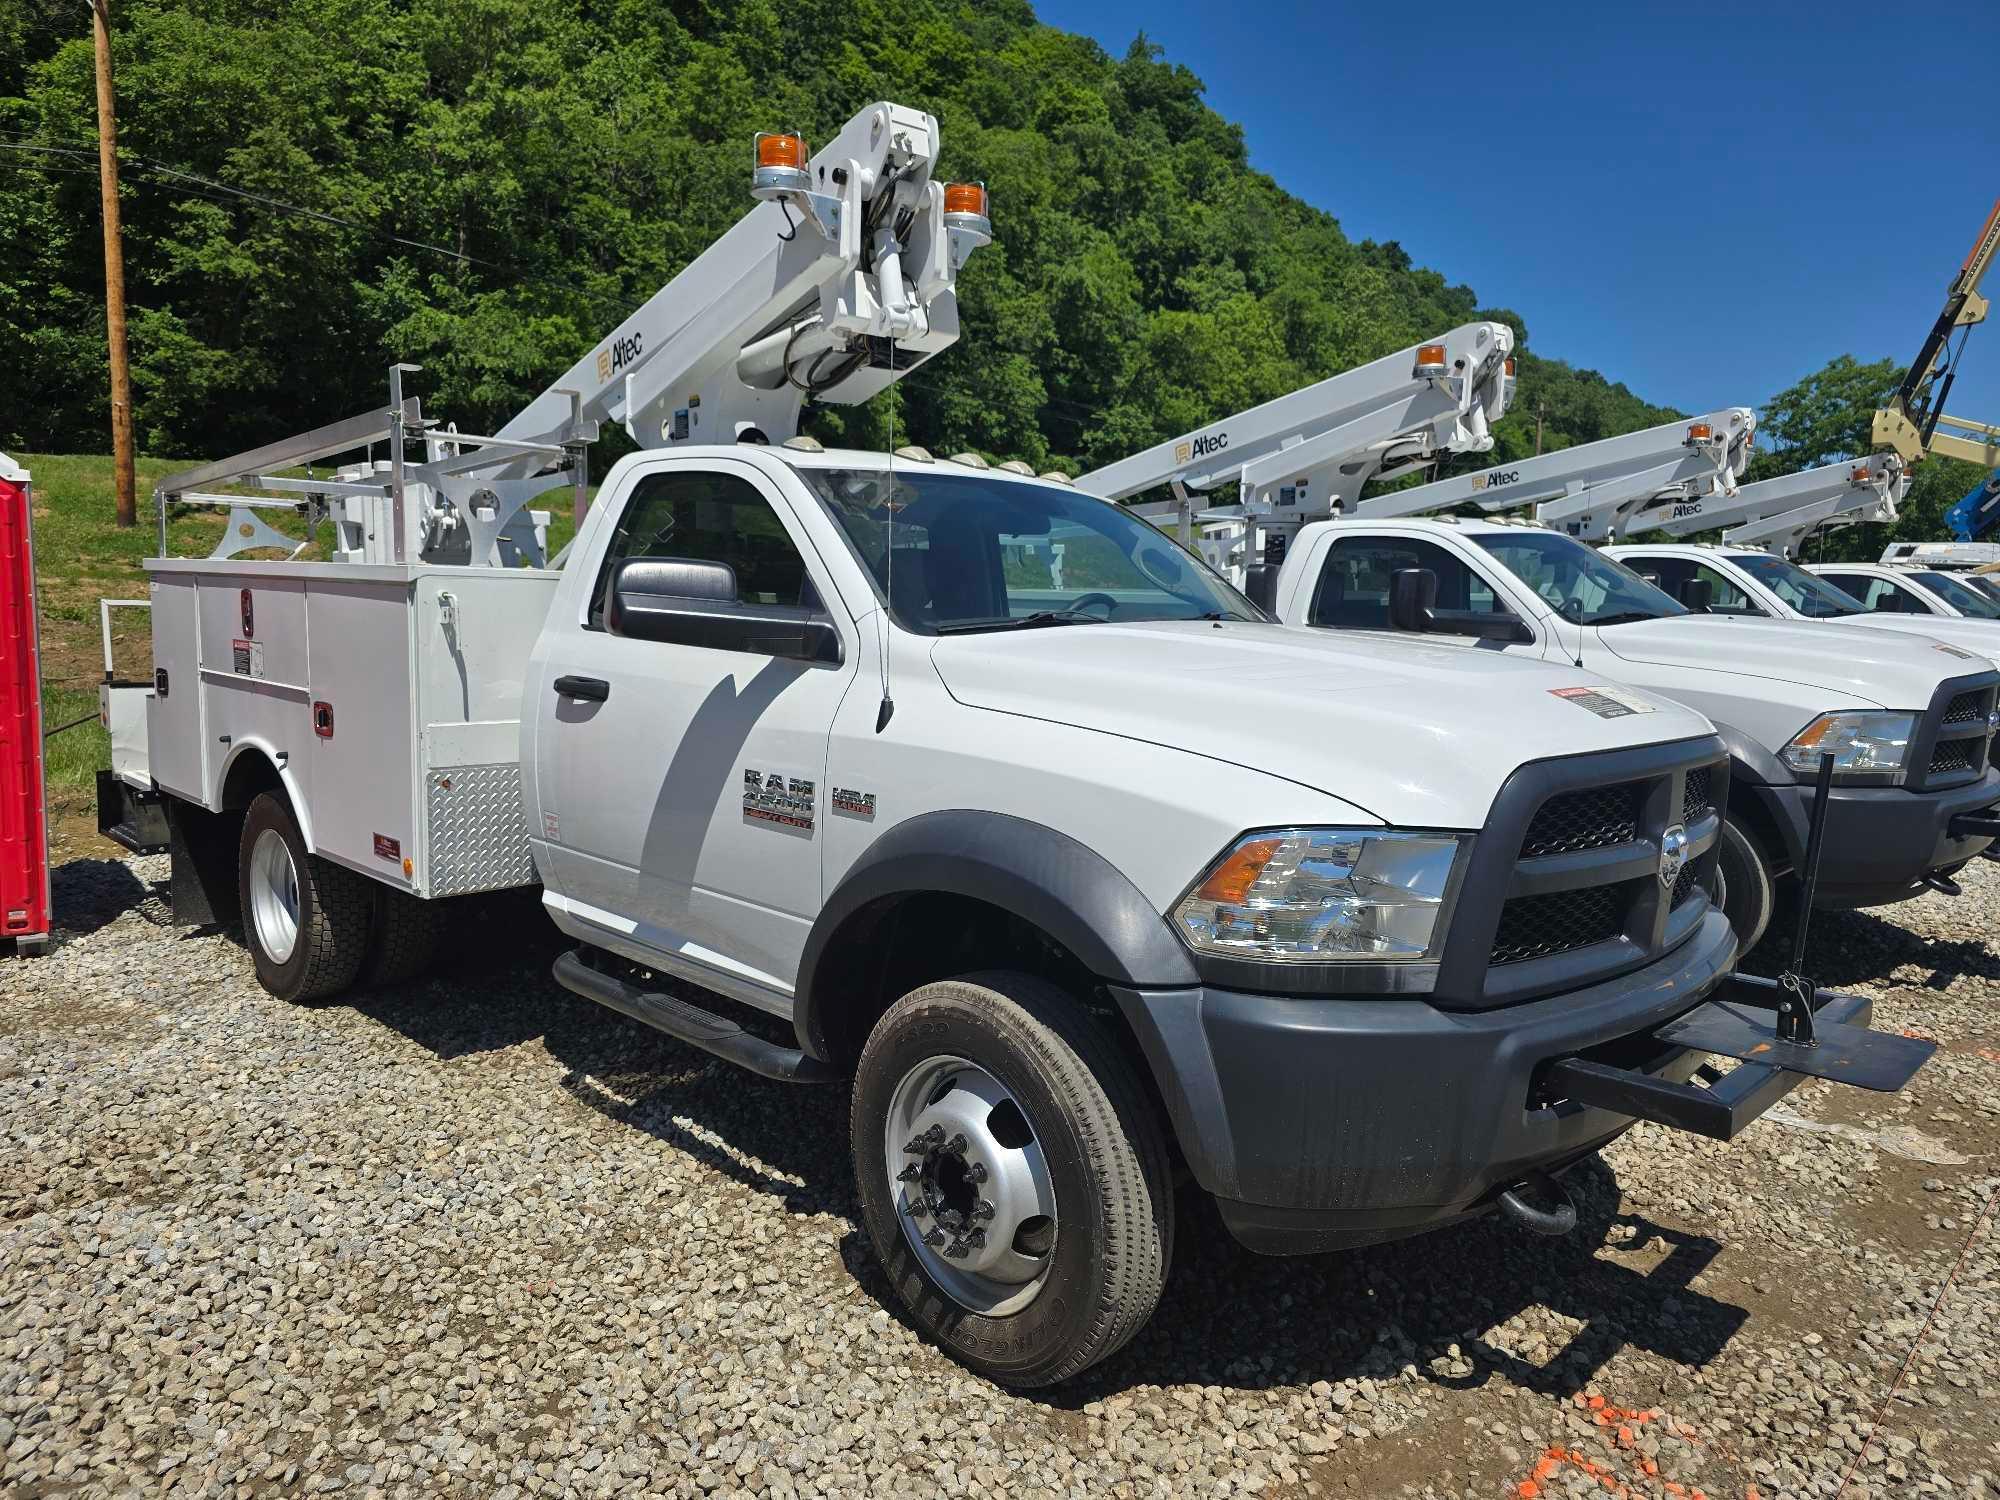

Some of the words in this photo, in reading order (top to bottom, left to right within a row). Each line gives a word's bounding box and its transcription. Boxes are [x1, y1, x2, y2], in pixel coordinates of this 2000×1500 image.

[612, 331, 643, 374] Altec
[1192, 433, 1228, 459] Altec
[1487, 470, 1519, 488] Altec
[1672, 503, 1702, 518] Altec
[744, 769, 815, 798] RAM
[780, 815, 810, 829] DUTY
